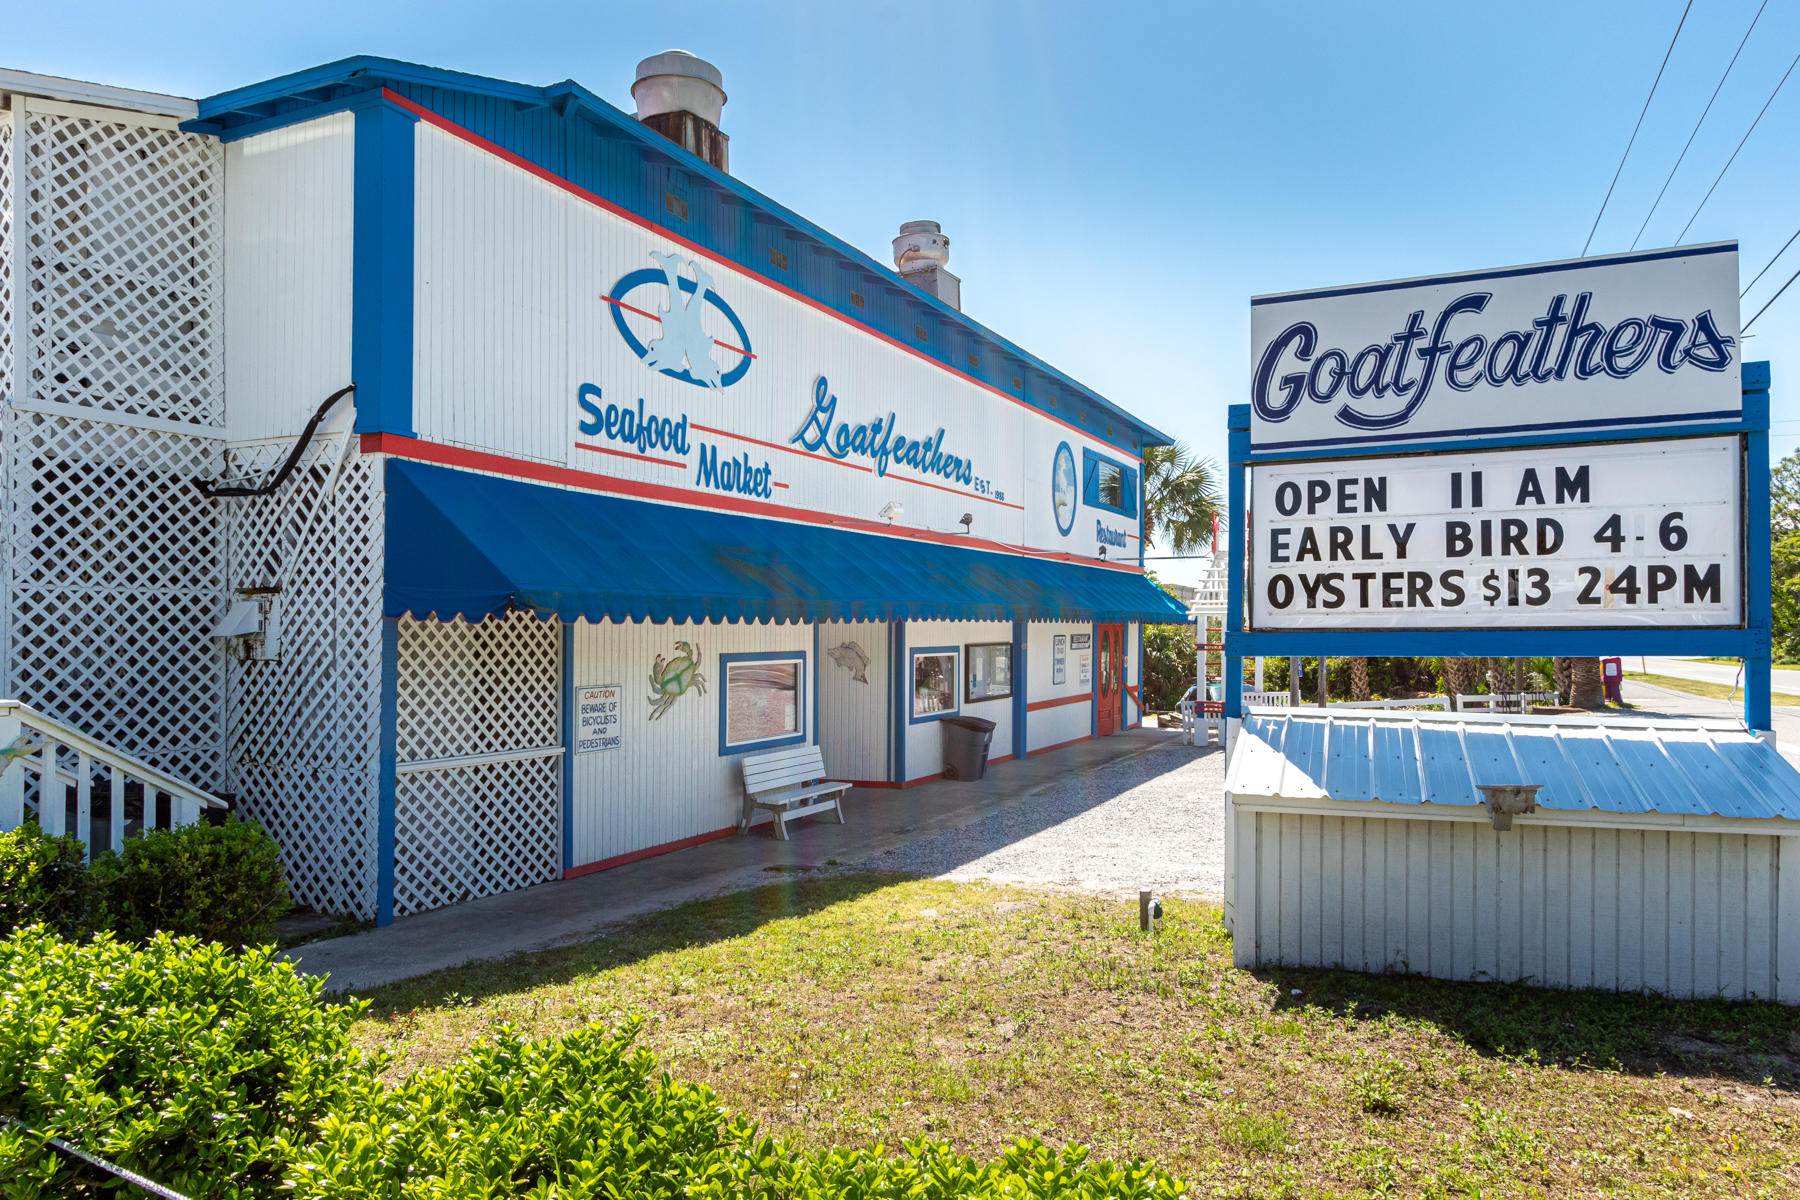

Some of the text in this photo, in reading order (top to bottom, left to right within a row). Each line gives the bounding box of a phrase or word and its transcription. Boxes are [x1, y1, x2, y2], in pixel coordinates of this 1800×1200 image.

[1252, 291, 1736, 431] Goatfeathers
[577, 381, 690, 456] Seafood
[789, 375, 973, 486] Goatfeathers
[696, 442, 773, 499] Market
[1274, 475, 1388, 517] OPEN
[1515, 464, 1591, 506] AM
[1269, 522, 1417, 563] EARLY
[1445, 517, 1565, 558] BIRD
[1266, 569, 1466, 610] OYSTERS
[1482, 567, 1552, 607] $13
[581, 702, 617, 715] BEWARE OF
[584, 690, 615, 700] CAUTION
[579, 736, 620, 749] PEDESTRIANS
[582, 714, 617, 727] BICYCLISTS
[592, 727, 608, 736] AND
